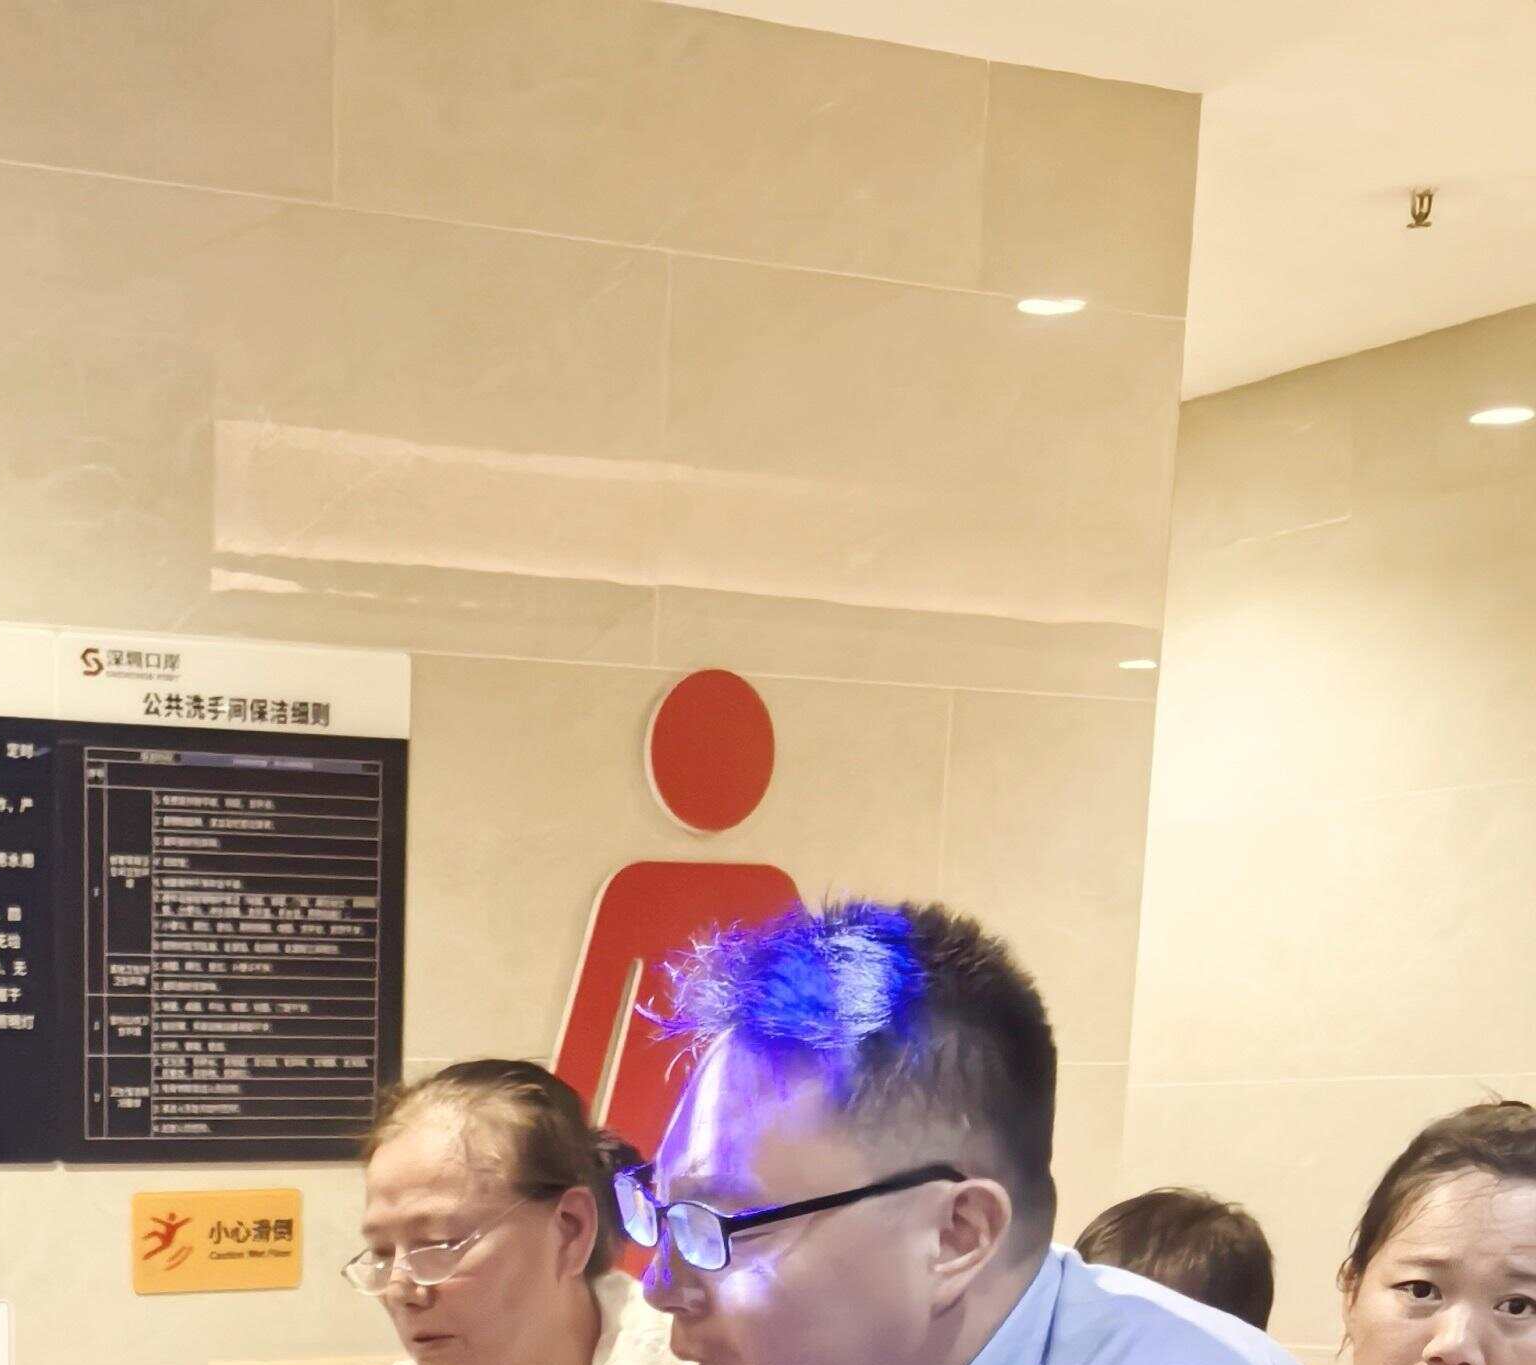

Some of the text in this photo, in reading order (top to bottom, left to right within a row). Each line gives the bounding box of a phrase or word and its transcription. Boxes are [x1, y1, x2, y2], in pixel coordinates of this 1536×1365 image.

[107, 649, 181, 671] 深圳口岸
[142, 692, 330, 727] 公共洗手间保洁细则
[209, 1218, 293, 1244] 小心滑倒
